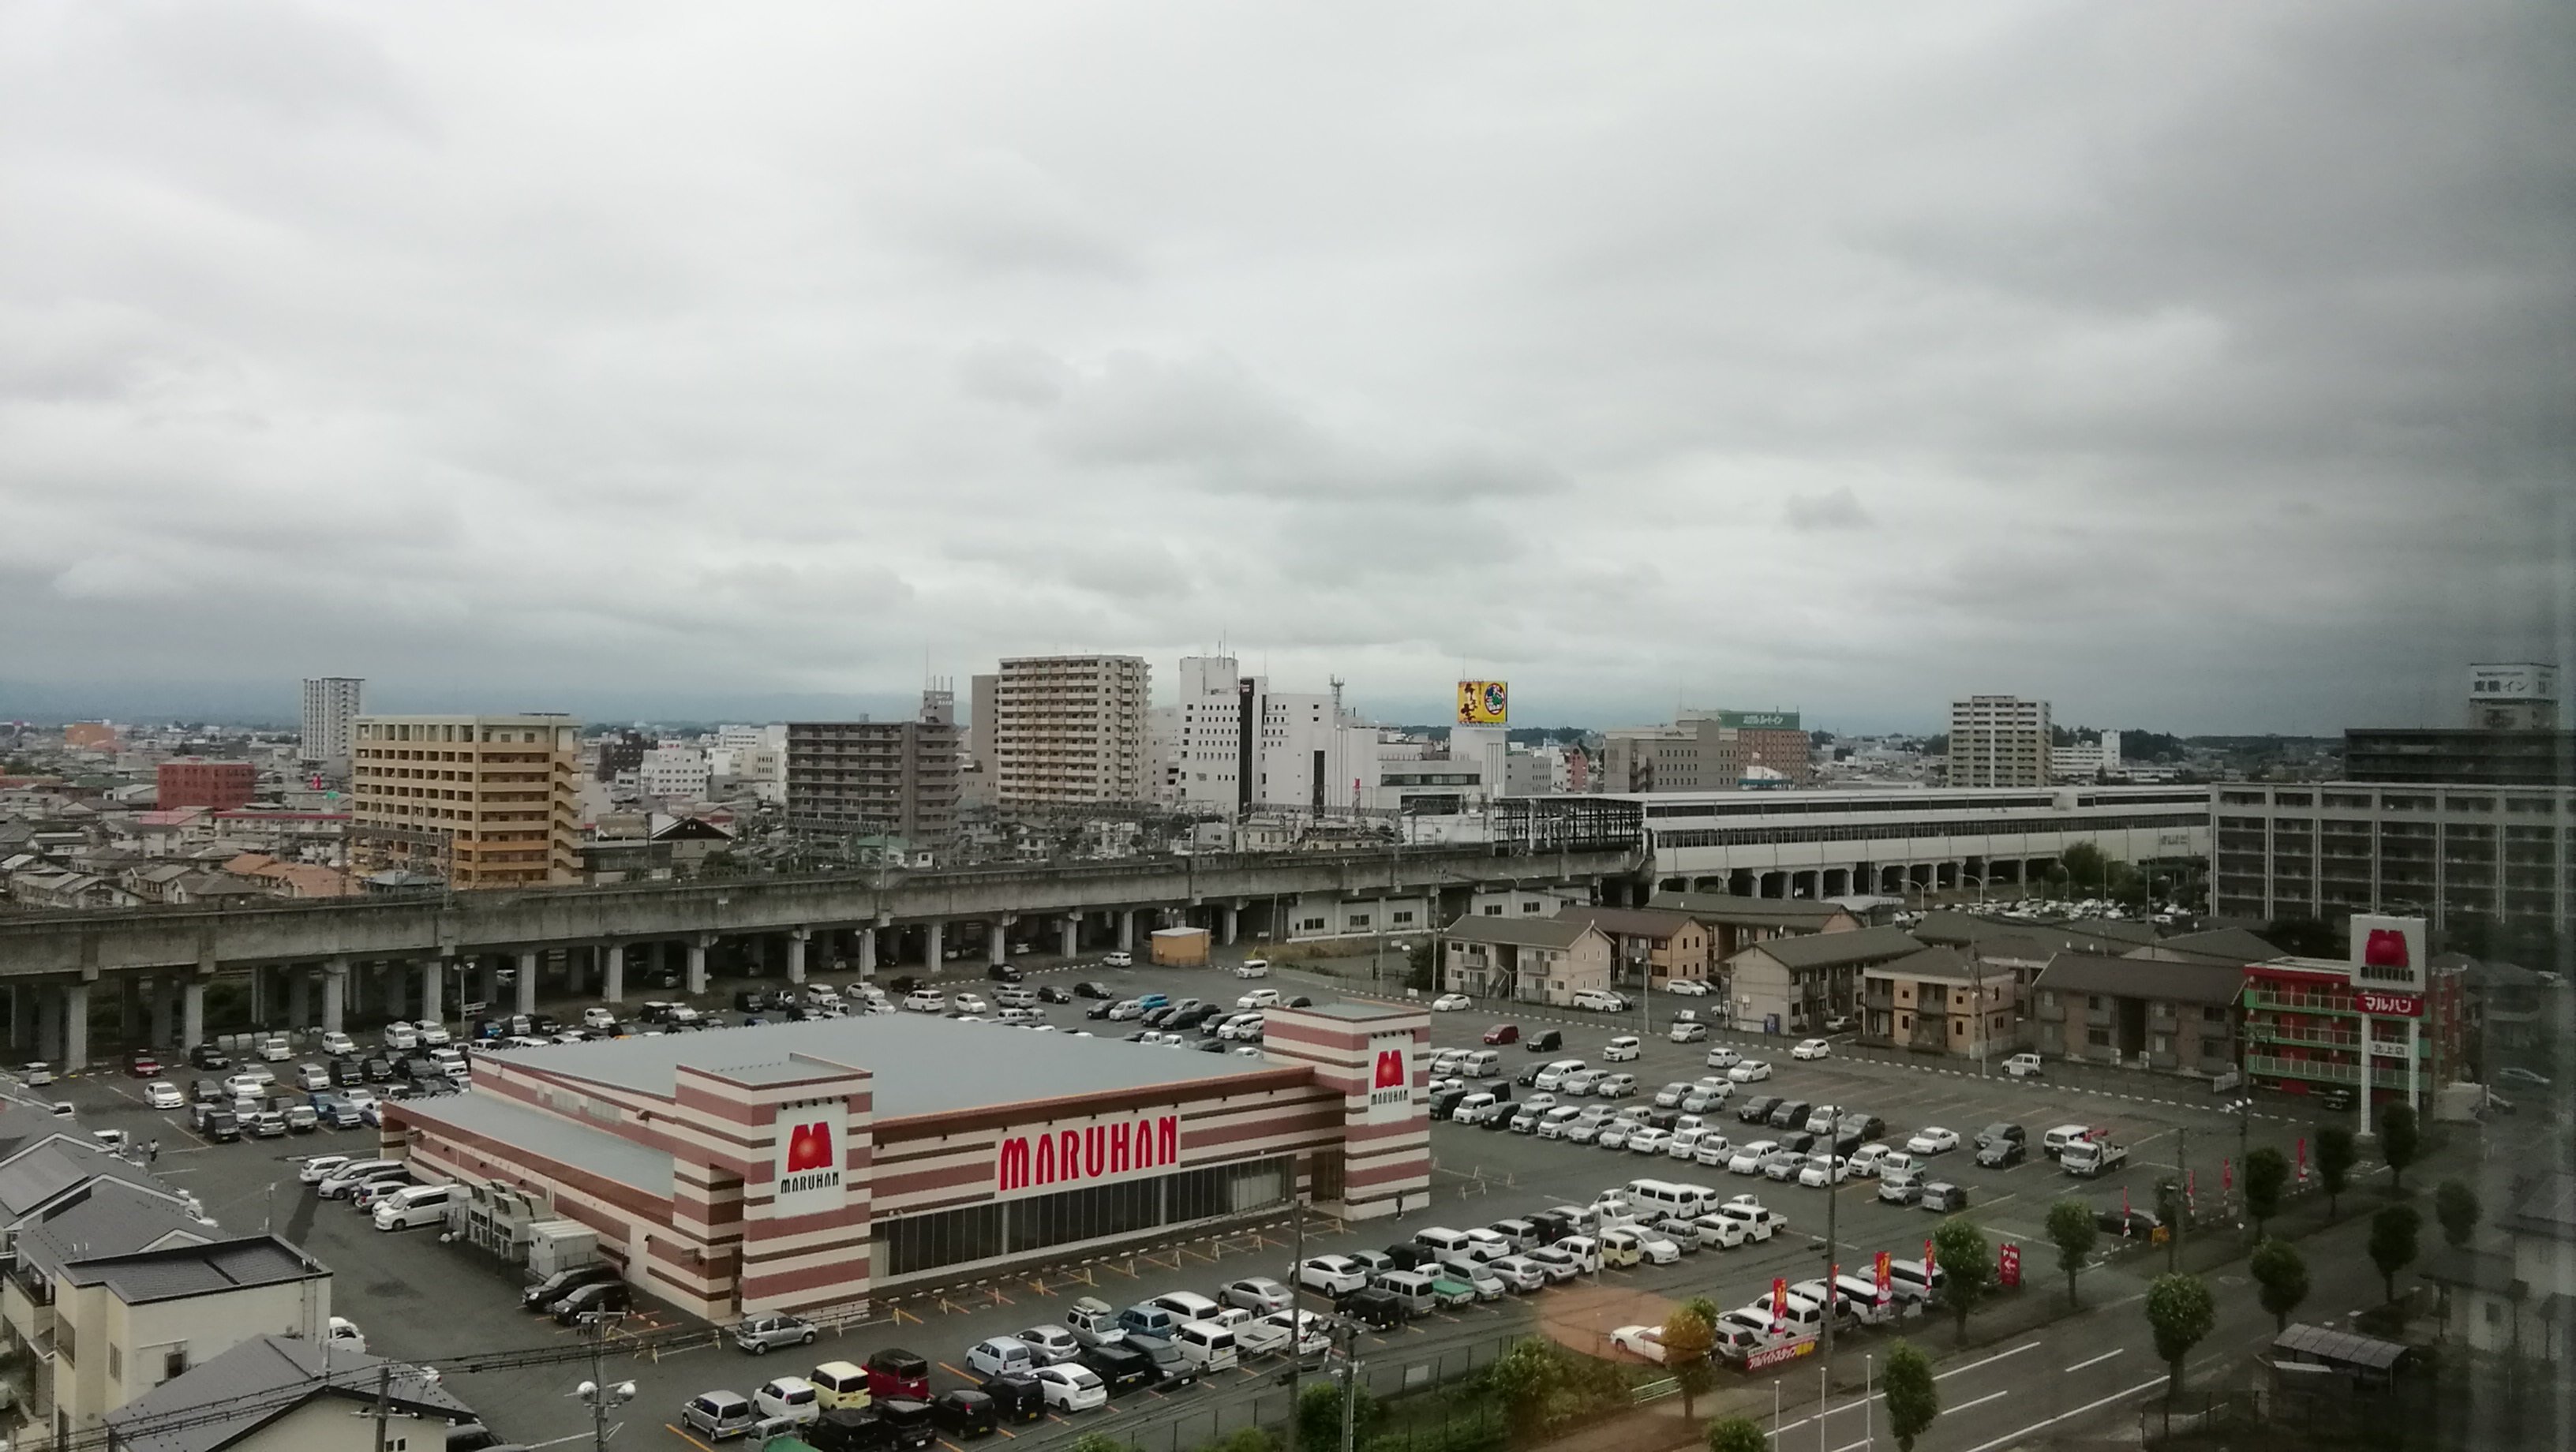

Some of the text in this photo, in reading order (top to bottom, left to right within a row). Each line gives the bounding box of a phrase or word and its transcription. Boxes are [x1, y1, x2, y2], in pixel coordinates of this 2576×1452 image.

[2364, 997, 2412, 1013] マルハン
[1371, 1090, 1408, 1106] MARUHAN
[999, 1115, 1177, 1191] MARUHAN
[781, 1171, 839, 1194] MARUHAN
